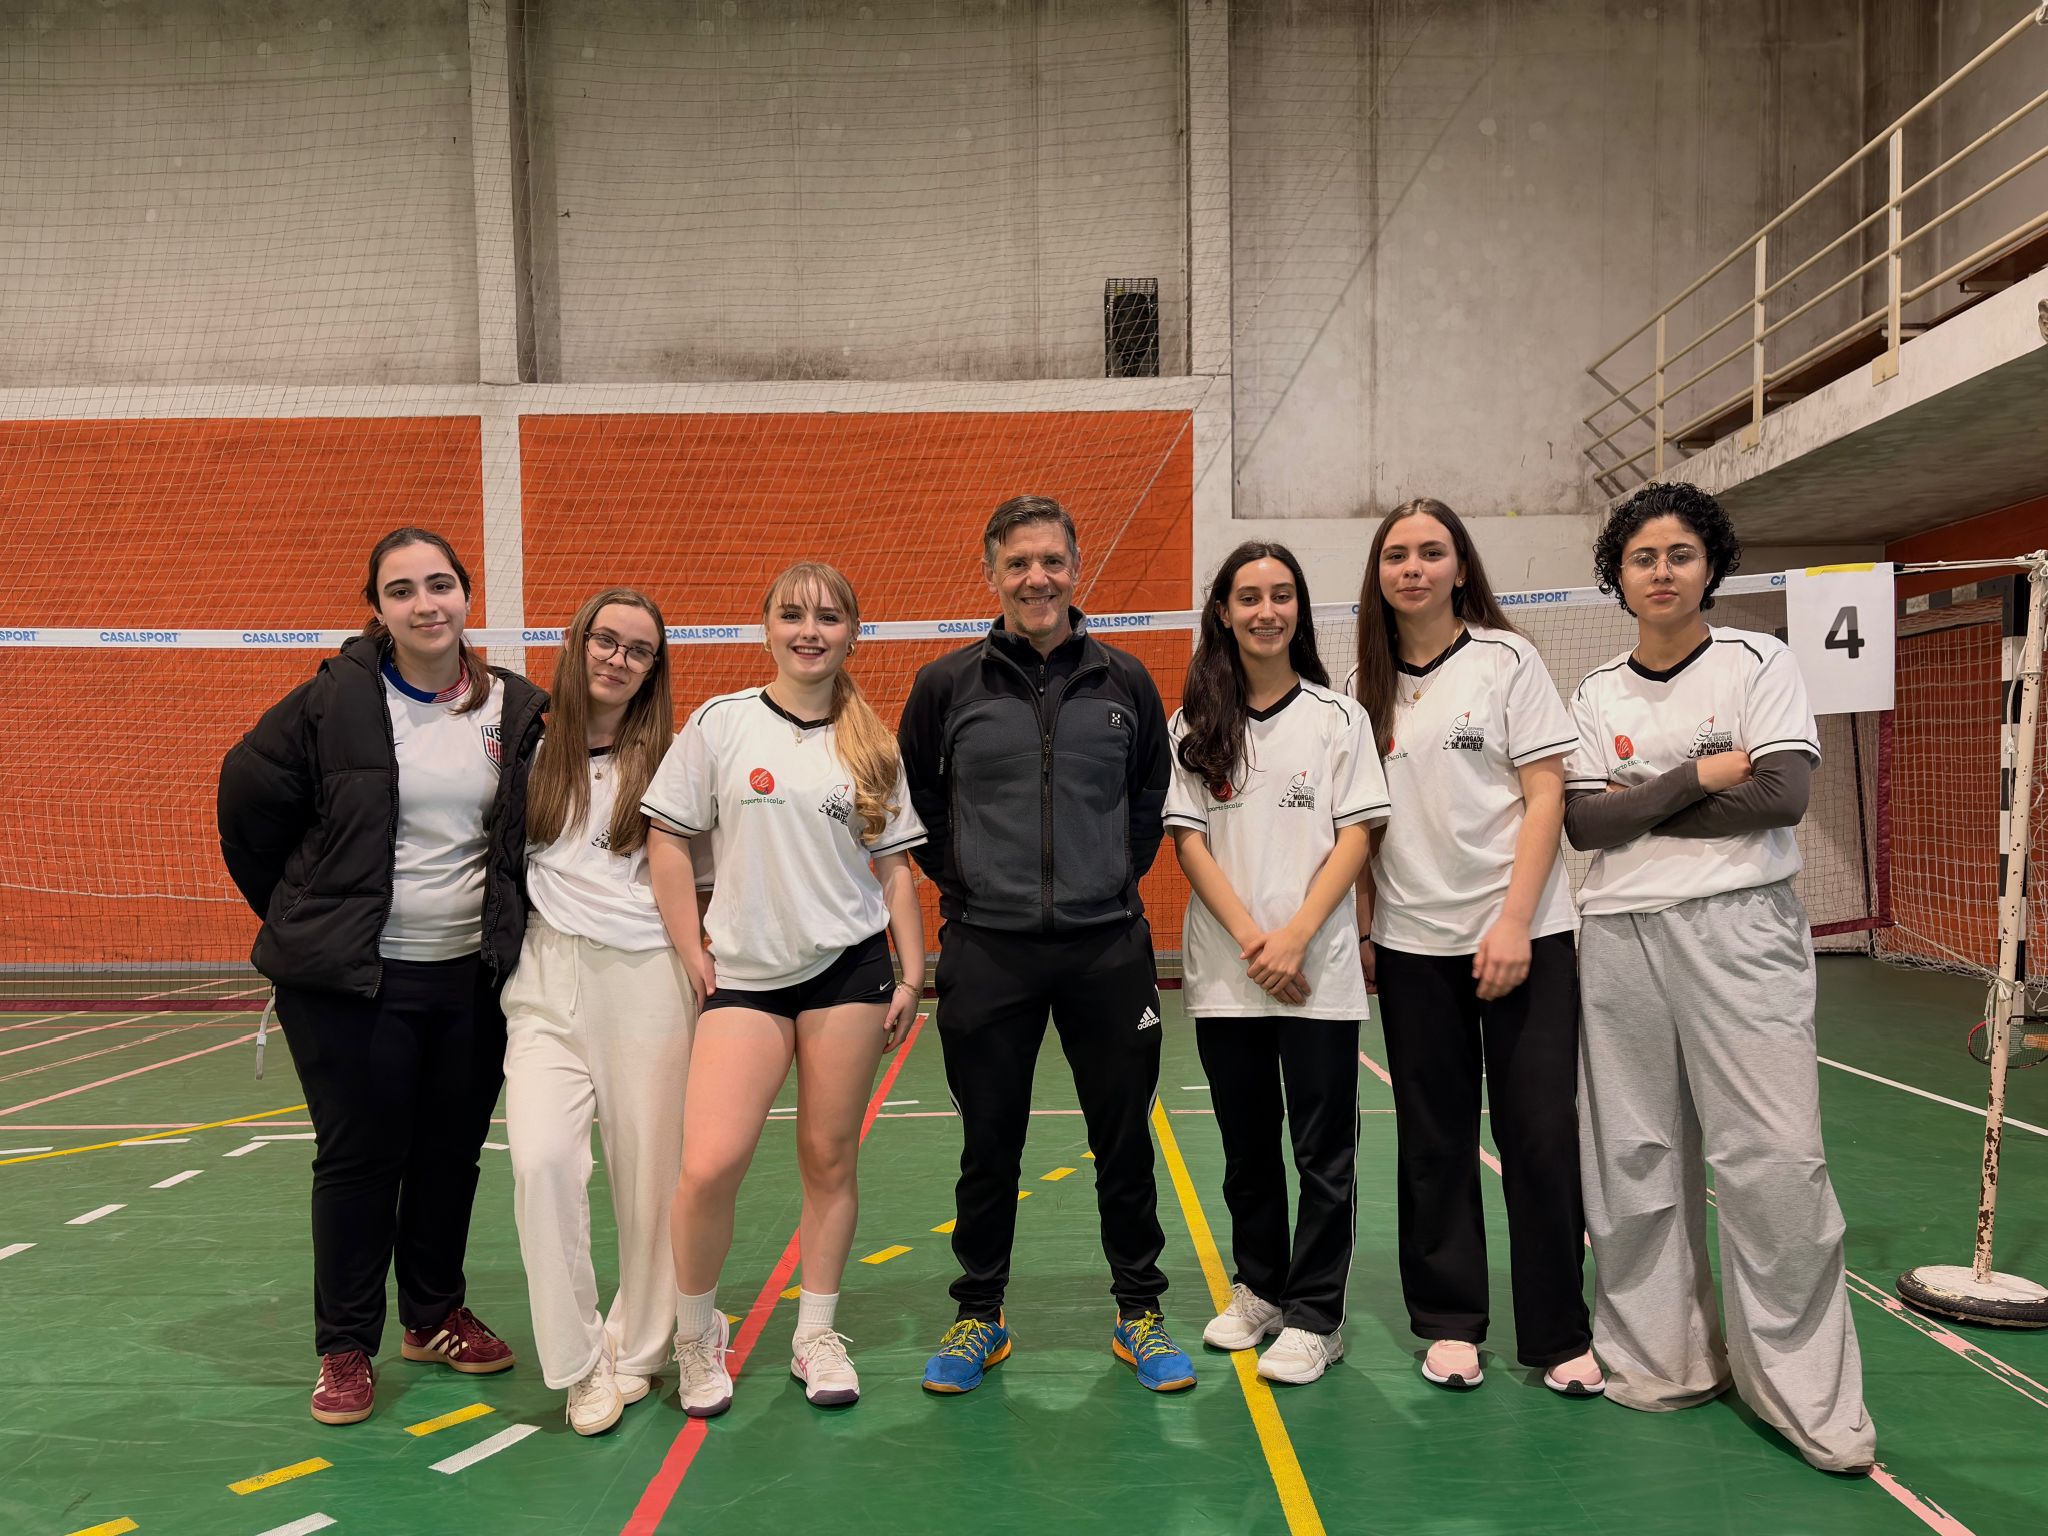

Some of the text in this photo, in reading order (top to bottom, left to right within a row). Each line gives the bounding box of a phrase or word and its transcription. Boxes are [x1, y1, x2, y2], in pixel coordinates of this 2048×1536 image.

[1085, 615, 1151, 628] ASALSPORT
[664, 627, 740, 639] CASALSPORT
[938, 622, 991, 633] CASALSP
[1825, 606, 1865, 659] 4
[0, 630, 37, 641] SPORT
[100, 631, 178, 643] CASALSPORT
[242, 632, 320, 643] CASALSPORT
[522, 631, 567, 641] CASALS
[485, 727, 502, 742] US
[1457, 735, 1484, 743] MORGADO
[1701, 741, 1732, 750] MORGADO
[1138, 1017, 1160, 1030] adidas
